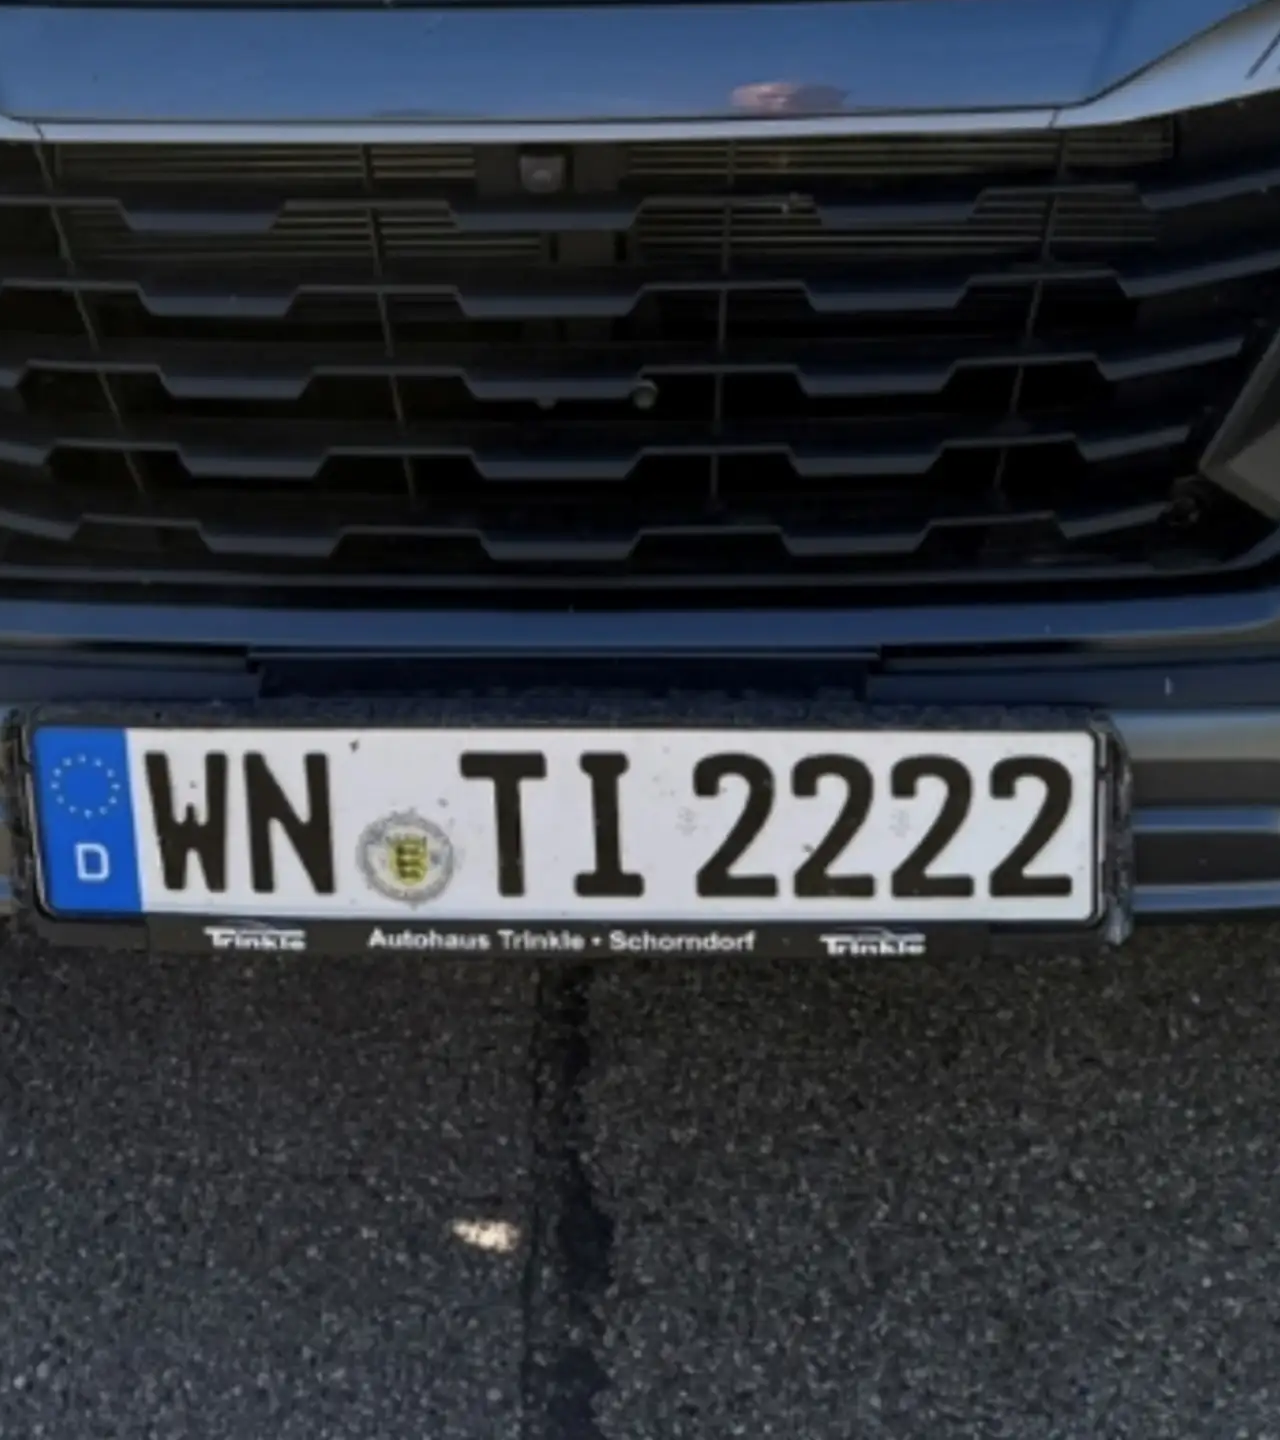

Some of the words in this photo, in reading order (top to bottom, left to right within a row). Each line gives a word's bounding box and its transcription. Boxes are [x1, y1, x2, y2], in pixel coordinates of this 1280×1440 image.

[144, 750, 337, 895] WN
[460, 752, 645, 897] TI
[693, 753, 1072, 897] 2222
[74, 843, 110, 882] D
[203, 926, 307, 951] Trinkle
[368, 928, 491, 950] Autohaus
[497, 929, 585, 951] Trinkle
[609, 929, 756, 951] Schorndorf
[819, 933, 926, 956] Trinkle
